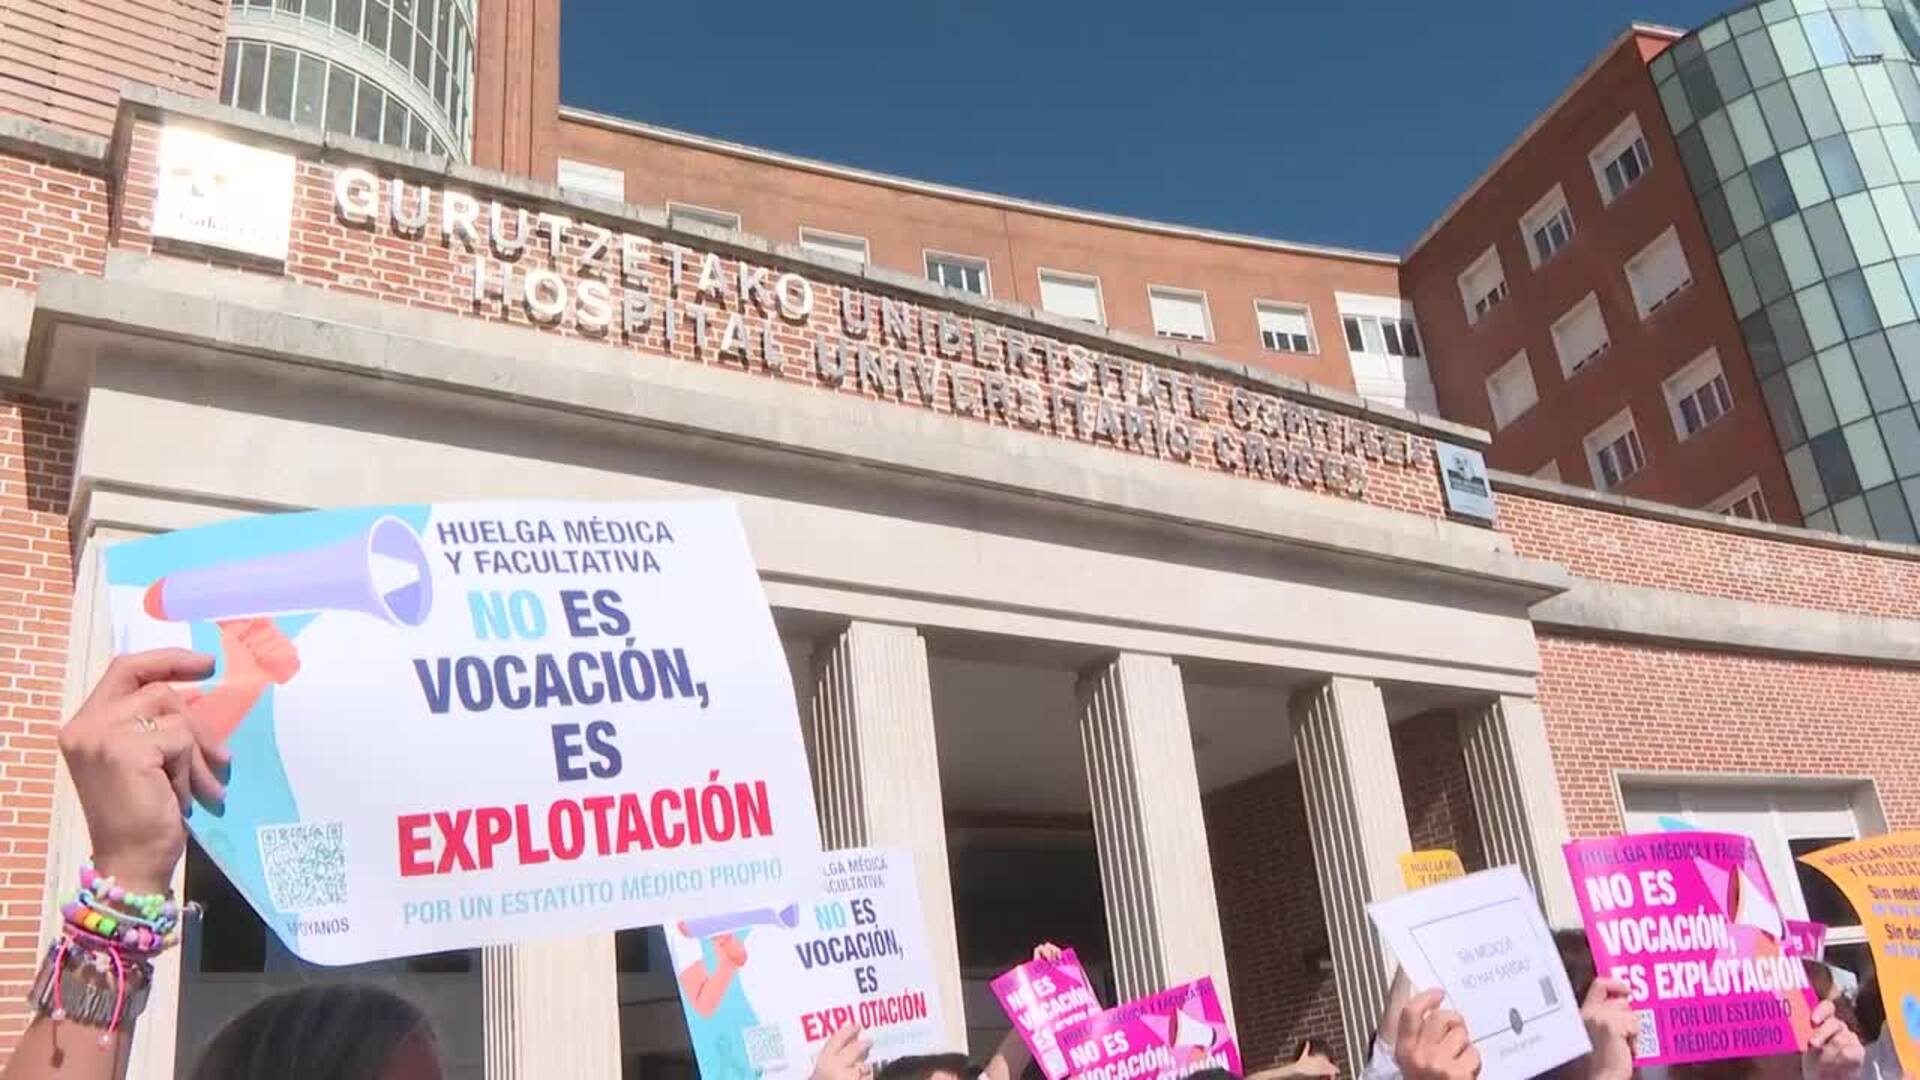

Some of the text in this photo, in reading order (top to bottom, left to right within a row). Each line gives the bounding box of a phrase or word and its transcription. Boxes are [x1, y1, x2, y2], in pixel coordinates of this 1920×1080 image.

[335, 168, 814, 321] GURUTZETAKO
[840, 285, 1210, 418] UNIBERTSITATE
[474, 256, 1368, 494] HOSPITAL UNIVERSITARIO CRUCES
[437, 516, 674, 544] HUELGA MÉDICA
[444, 550, 661, 574] Y FACULTATIVA
[467, 589, 632, 640] NO ES
[413, 637, 709, 714] VOCACIÓN,
[551, 720, 623, 782] ES
[397, 770, 773, 877] EXPLOTACIÓN
[849, 856, 889, 873] MÉDICA
[1579, 848, 1647, 865] HUELGA
[403, 857, 783, 924] POR UN ESTATUTO MÉDICO PROPIO
[1585, 868, 1677, 912] NO ES
[814, 897, 876, 932] NO ES
[1596, 904, 1737, 957] VOCACIÓN,
[796, 924, 904, 970] VOCACIÓN,
[854, 965, 879, 995] ES
[1654, 946, 1810, 1000] EXPLOTACIÓN
[1670, 998, 1793, 1028] POR UN ESTATUTO
[1069, 1040, 1100, 1069] NO
[1103, 1030, 1130, 1057] ES
[1674, 1026, 1784, 1053] MÉDICO PROPIO
